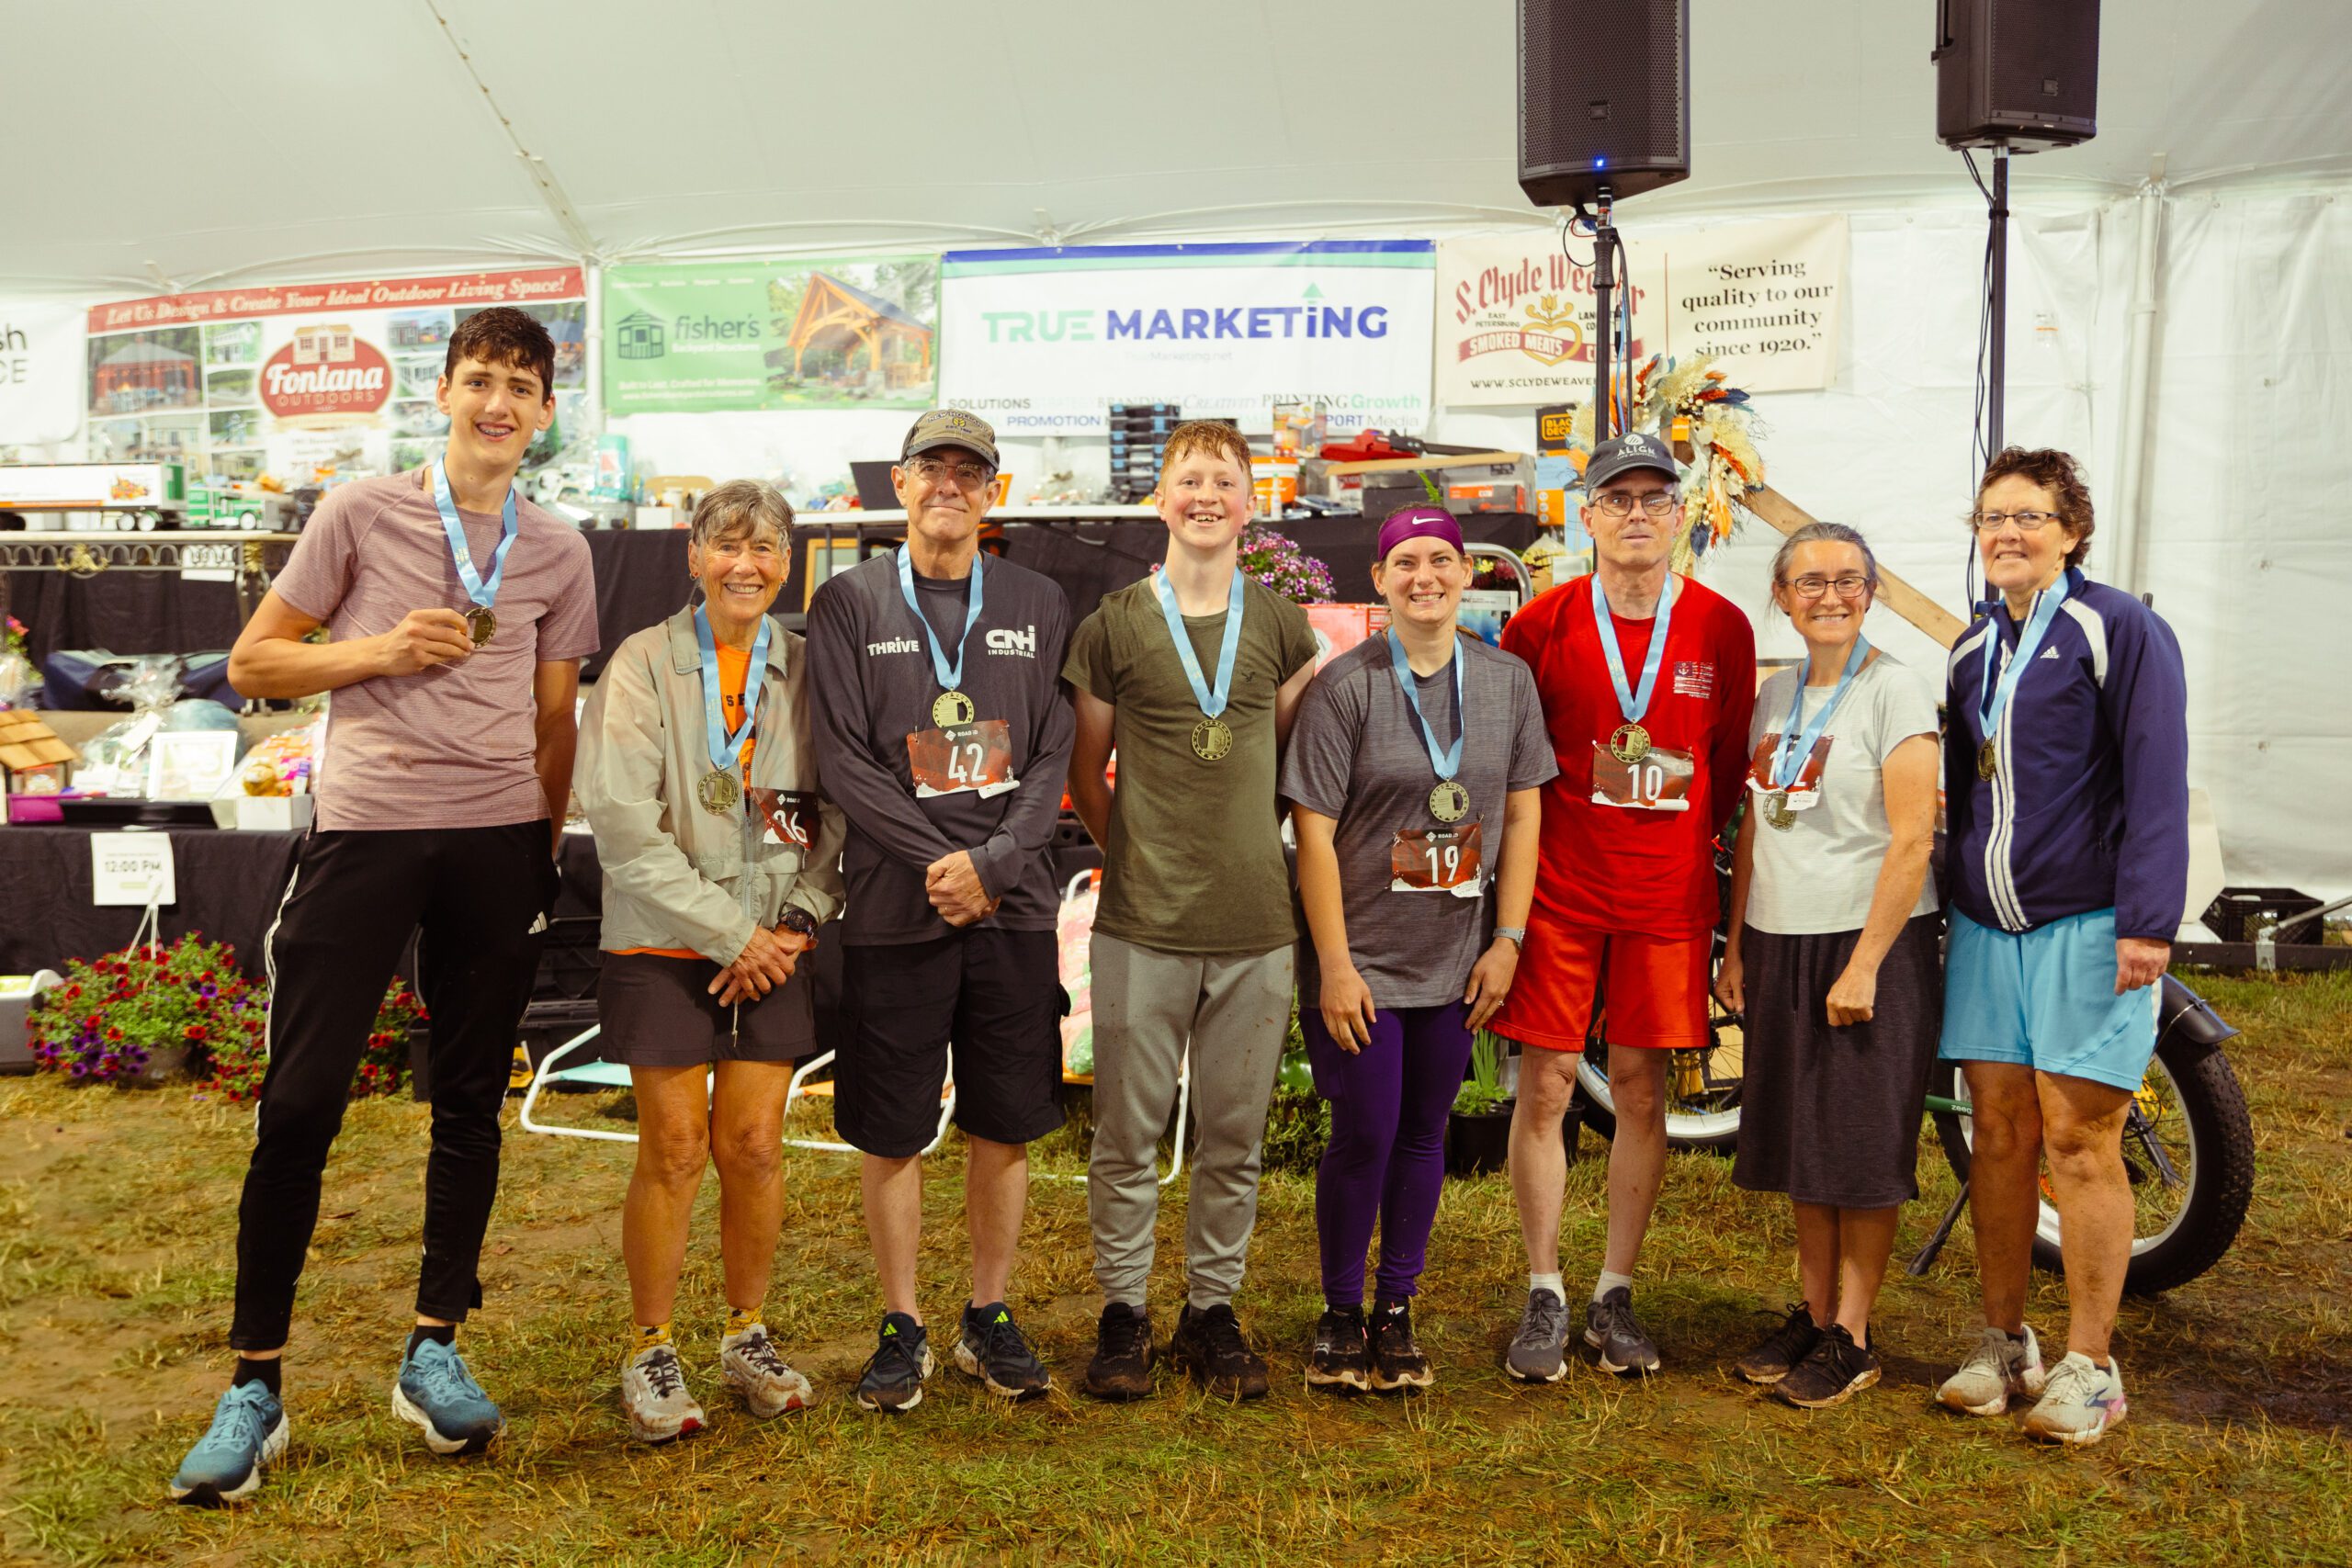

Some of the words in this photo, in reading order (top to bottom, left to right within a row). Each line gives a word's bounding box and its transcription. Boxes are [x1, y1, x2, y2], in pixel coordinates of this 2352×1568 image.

[1478, 257, 1543, 310] Clyde
[1548, 254, 1645, 316] Wear
[107, 308, 132, 326] Let
[134, 306, 155, 321] Us
[155, 300, 209, 321] Design
[212, 297, 228, 314] &
[230, 294, 281, 312] Create
[284, 290, 325, 309] Your
[325, 288, 371, 306] Ideal
[372, 284, 447, 302] Outdoor
[447, 279, 506, 300] Living
[507, 275, 567, 299] Space!
[1682, 288, 1760, 312] quality
[1767, 287, 1788, 302] to
[1793, 284, 1834, 299] our
[1475, 320, 1521, 328] PETERSBURG
[1487, 311, 1507, 320] EAST
[1694, 308, 1822, 333] community
[981, 310, 1096, 343] TRUE
[1469, 333, 1521, 356] SMOKED
[1524, 332, 1564, 355] MEATS
[1695, 341, 1751, 356] since
[266, 363, 385, 396] Fontana
[1471, 377, 1596, 389] WWW.SCLYDEWEAVE
[277, 389, 376, 407] OUTDOORS
[948, 398, 1031, 410] SOLUTIONS
[1262, 393, 1348, 408] PRINTING
[1351, 393, 1421, 410] Growth
[1007, 415, 1101, 427] PROMOTION
[1367, 415, 1419, 427] Media
[1617, 446, 1656, 457] ALIGN
[988, 649, 1035, 659] INDUSTRIAL
[948, 742, 988, 784] 42
[1627, 764, 1663, 801] 10
[104, 860, 138, 873] 12:00
[142, 860, 163, 872] PM
[1426, 845, 1459, 884] 19
